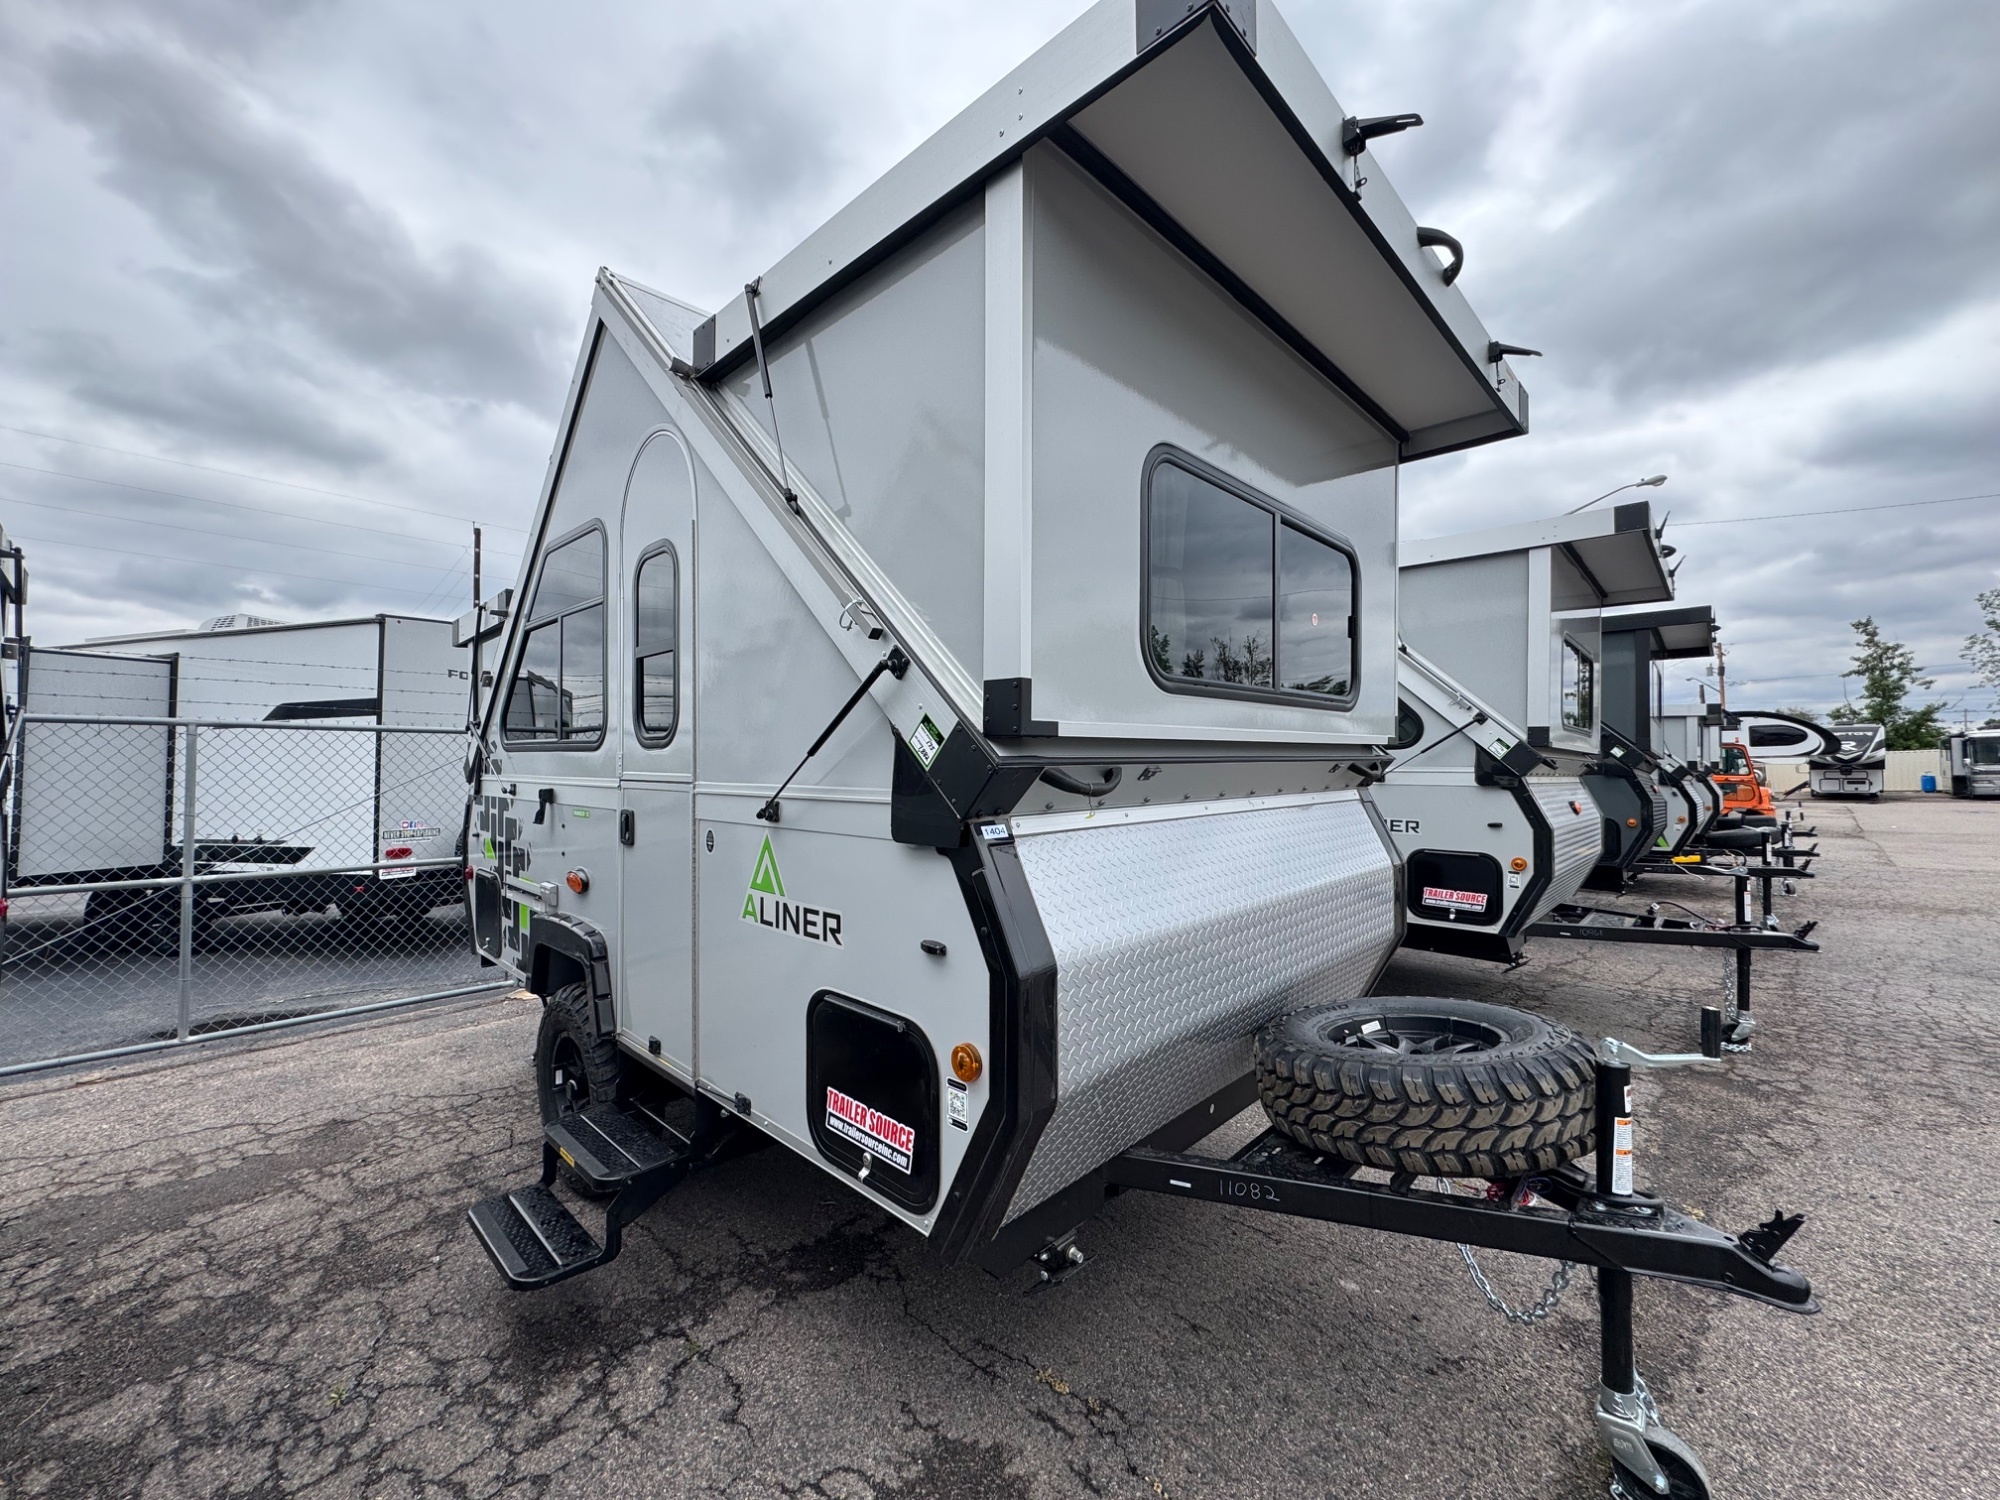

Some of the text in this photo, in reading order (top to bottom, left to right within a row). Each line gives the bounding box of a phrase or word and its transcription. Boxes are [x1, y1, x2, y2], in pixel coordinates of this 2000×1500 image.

[984, 827, 1006, 836] 1404
[1424, 888, 1487, 904] TRAILER SOURCE
[742, 893, 842, 946] ALINER
[828, 1089, 914, 1153] TRAILER SOURCE
[829, 1115, 908, 1168] www.trailersourceinc.com
[1219, 1179, 1281, 1201] 11082
